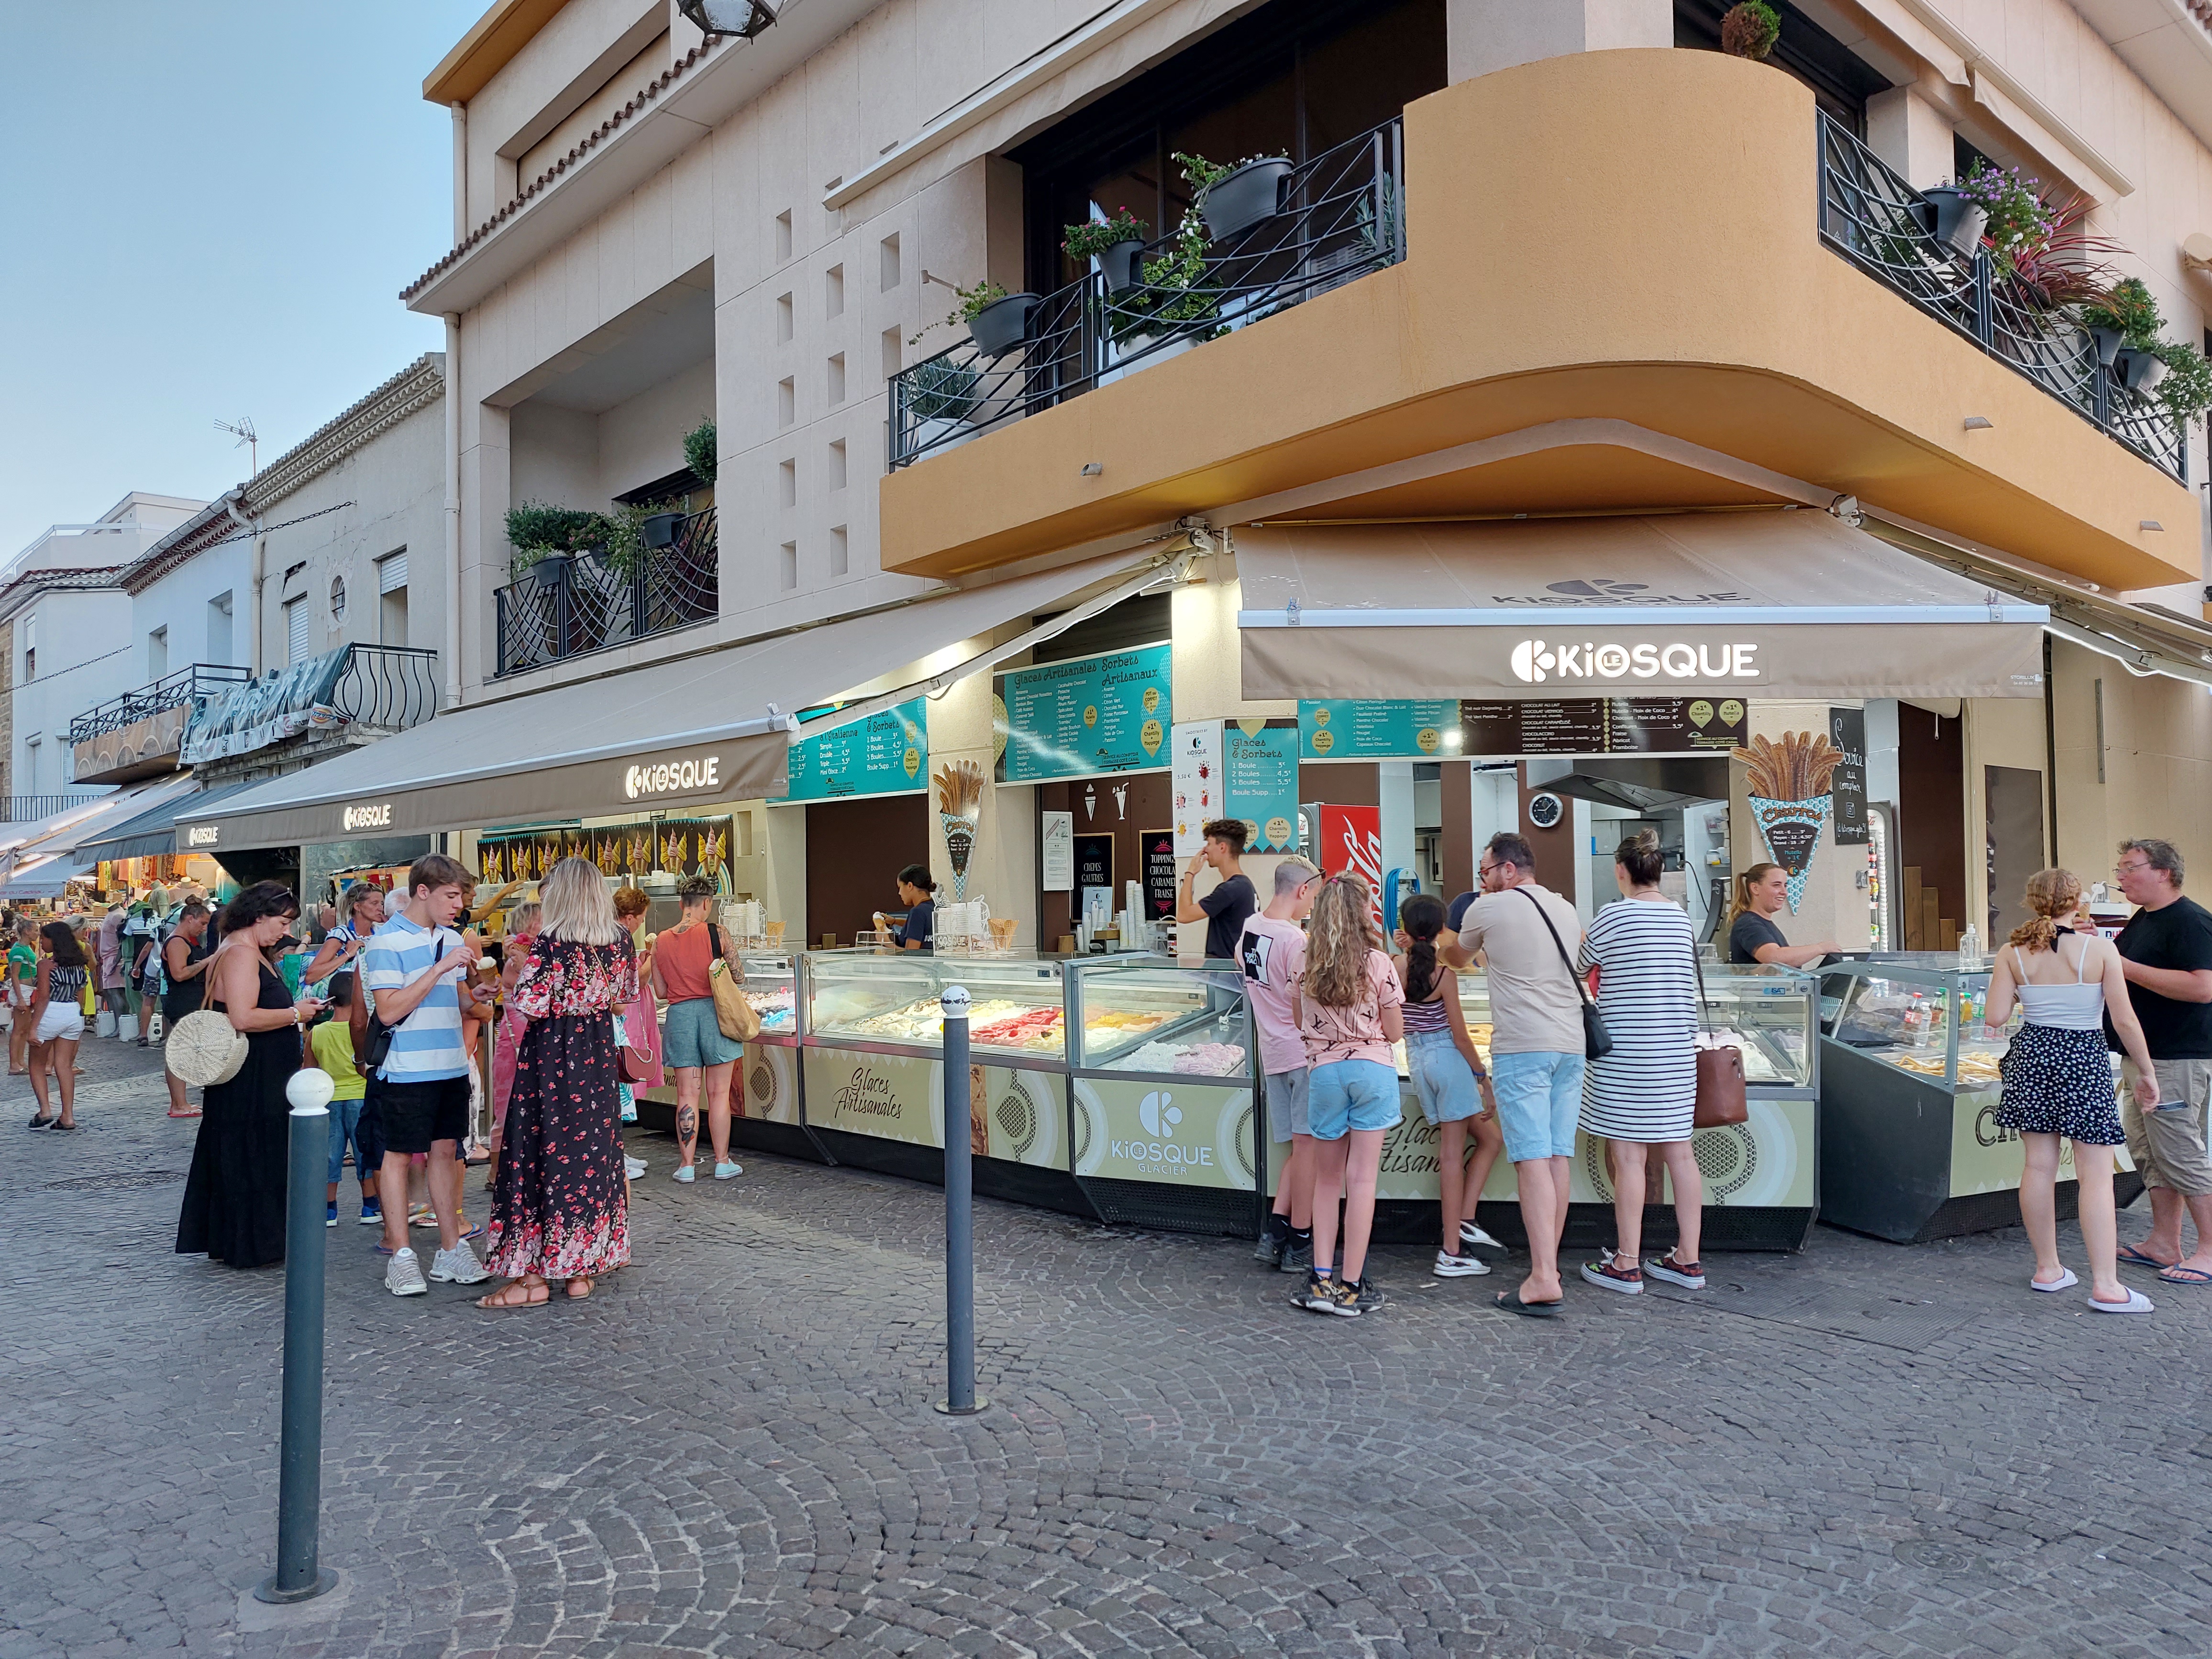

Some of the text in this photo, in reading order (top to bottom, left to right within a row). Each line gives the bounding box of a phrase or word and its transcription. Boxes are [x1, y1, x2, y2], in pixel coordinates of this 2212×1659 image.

[1102, 655, 1139, 672] Sorbets
[1603, 654, 1622, 667] LE
[1015, 663, 1097, 689] Glaces Artisanales
[1102, 669, 1158, 686] Artisanaux
[873, 719, 900, 733] Sorbets
[1231, 738, 1266, 750] Glaces
[1241, 749, 1283, 760] Sorbets
[1847, 770, 1857, 779] au
[1762, 807, 1823, 823] Churros
[1150, 866, 1175, 875] CHOCOLA
[1082, 874, 1104, 883] GAUFRES
[1154, 889, 1174, 898] FRAISE
[851, 1067, 891, 1095] Glaces
[832, 1085, 903, 1119] Artisanales
[1133, 1147, 1144, 1155] LE
[1138, 1163, 1188, 1176] GLACIER
